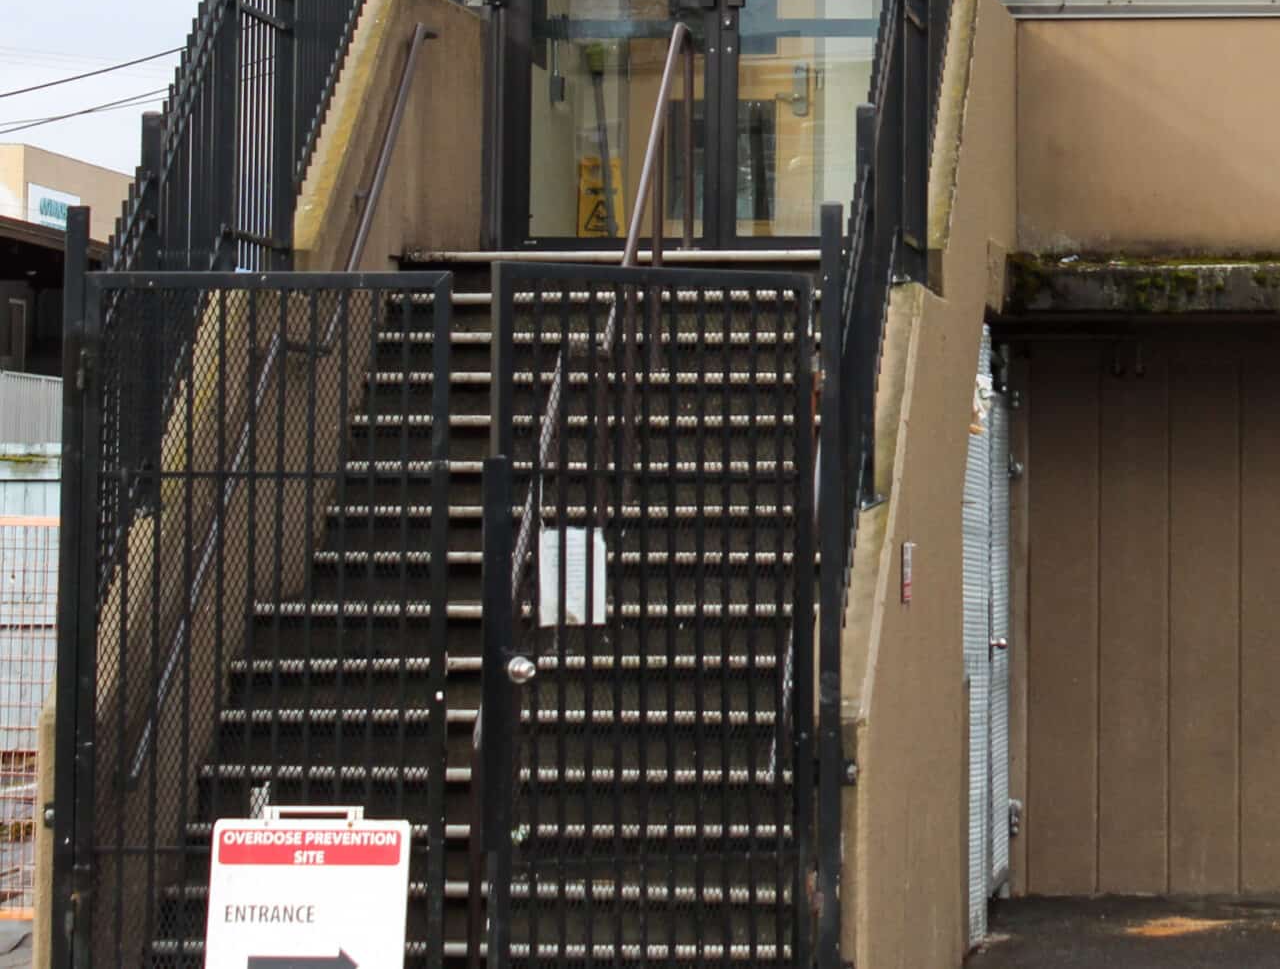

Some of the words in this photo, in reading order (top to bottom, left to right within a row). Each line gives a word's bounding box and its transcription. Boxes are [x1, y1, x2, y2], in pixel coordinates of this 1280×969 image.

[223, 831, 303, 846] OVERDOSE
[304, 831, 397, 846] PREVENTION
[293, 850, 325, 864] SITE
[224, 904, 315, 923] ENTRANCE
